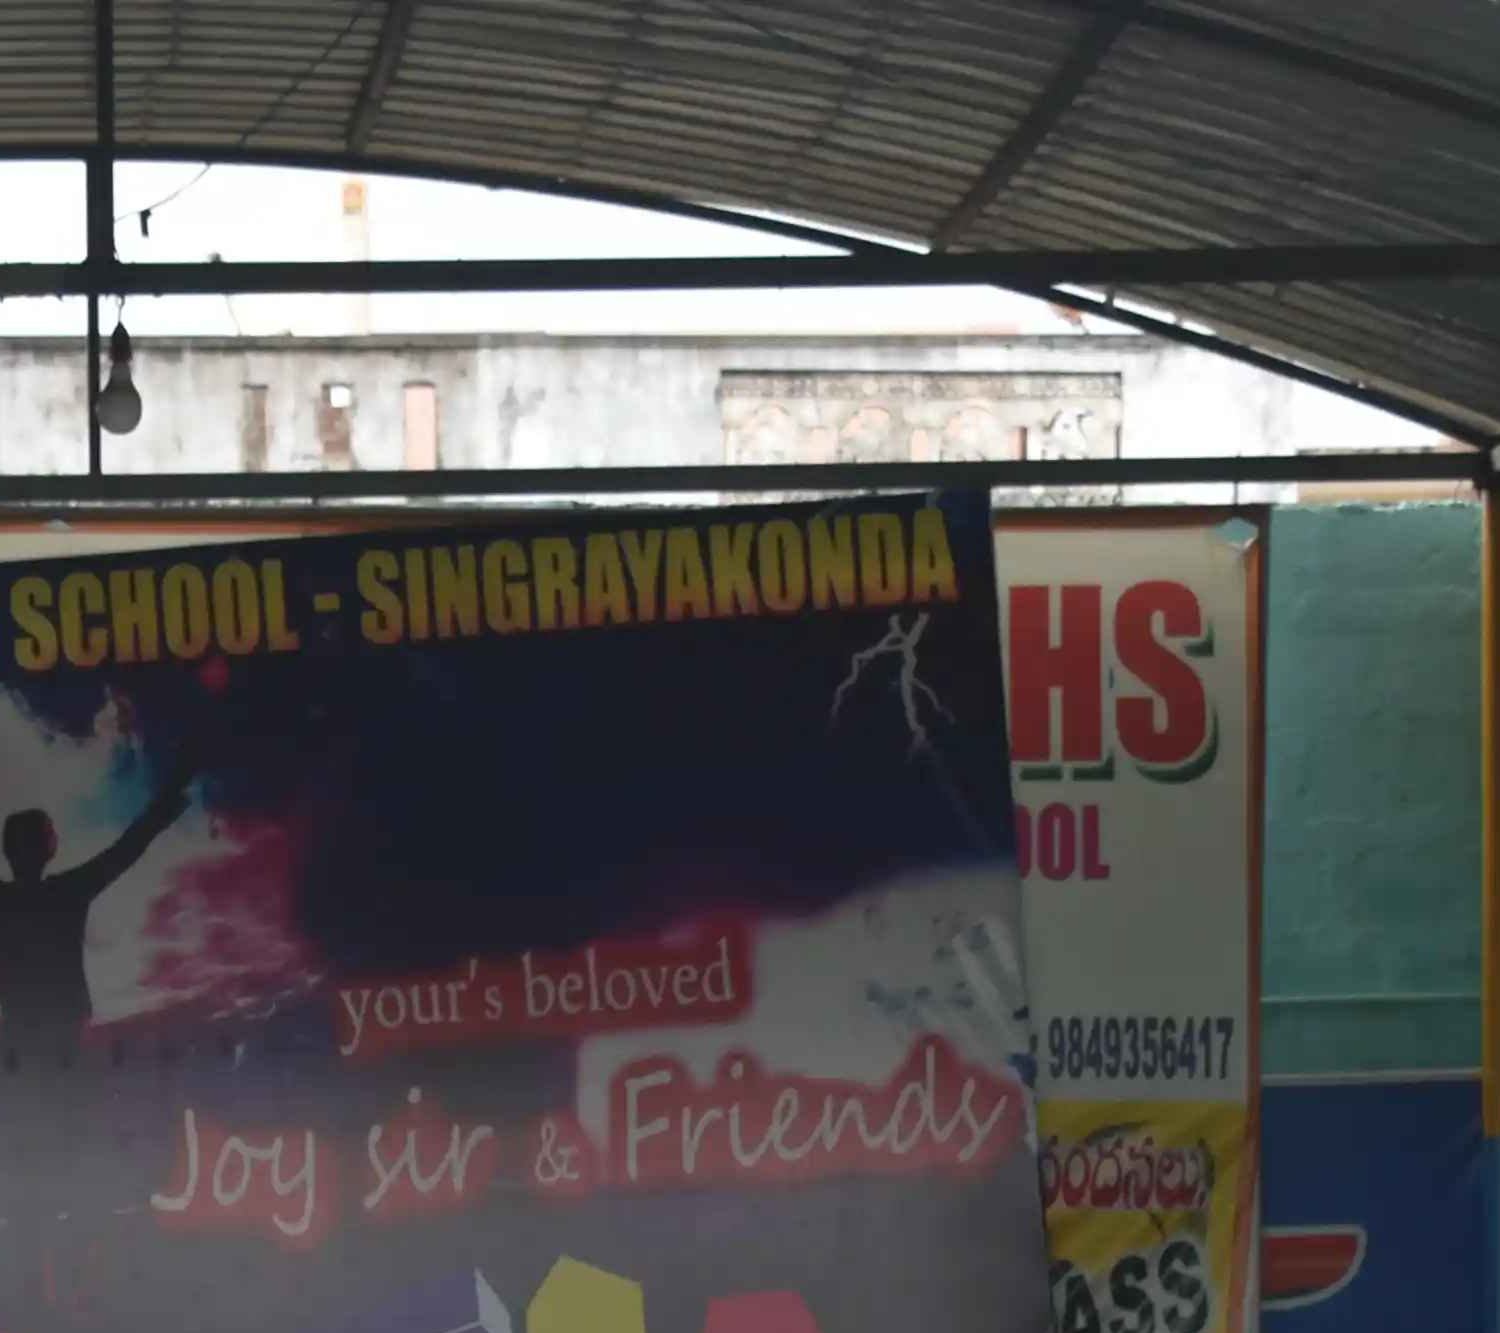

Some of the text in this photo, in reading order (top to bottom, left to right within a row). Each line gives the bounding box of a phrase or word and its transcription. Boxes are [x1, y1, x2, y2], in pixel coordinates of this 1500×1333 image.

[13, 555, 299, 672] SCHOOL
[357, 505, 959, 647] SINGRAYAKONDA
[1012, 578, 1214, 764] HS
[337, 938, 737, 1057] your's beloved
[1048, 1017, 1235, 1079] 9849356417
[149, 1052, 1009, 1240] Joy sir & Friends
